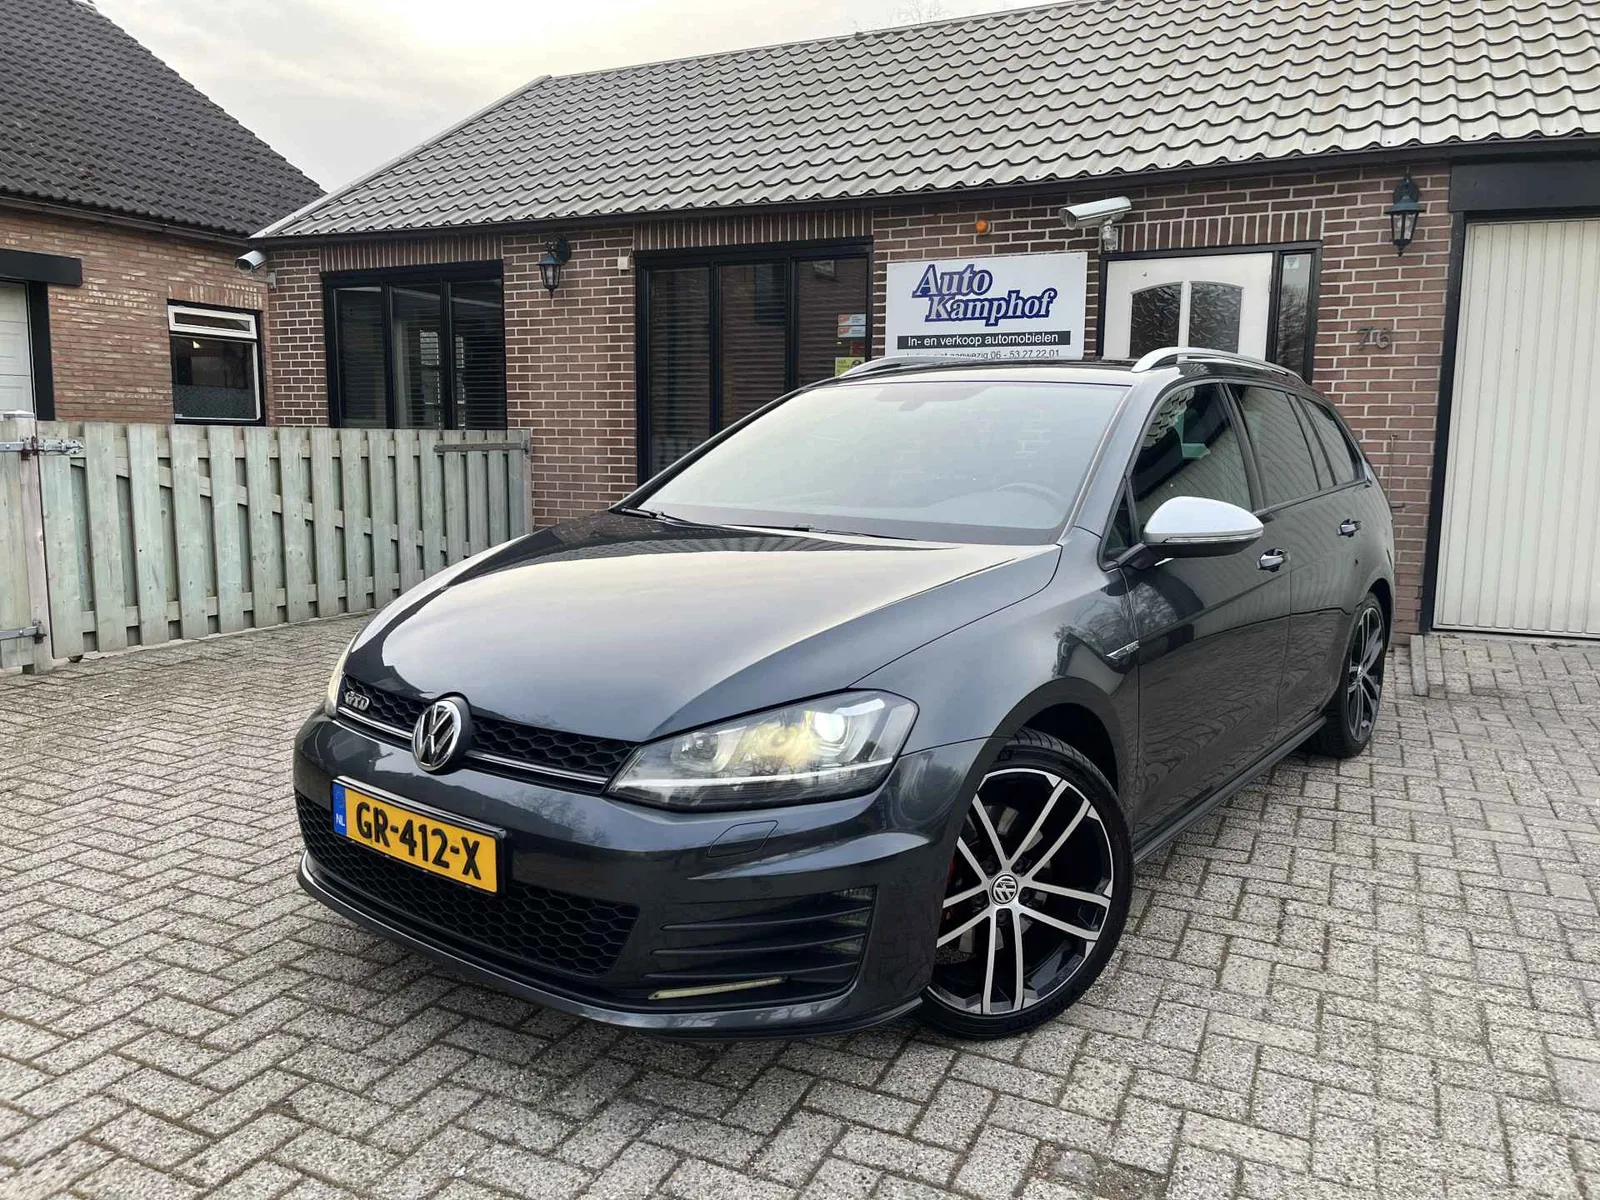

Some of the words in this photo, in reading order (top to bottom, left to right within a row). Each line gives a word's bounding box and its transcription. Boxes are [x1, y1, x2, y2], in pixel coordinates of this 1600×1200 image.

[912, 264, 993, 298] Auto
[924, 287, 1058, 327] Kamphof
[908, 336, 922, 347] In-
[924, 338, 937, 347] en
[940, 335, 982, 348] verkoop
[984, 333, 1059, 346] automobielen
[1357, 326, 1392, 351] 76
[335, 812, 346, 827] NL
[355, 801, 482, 881] GR-412-X
